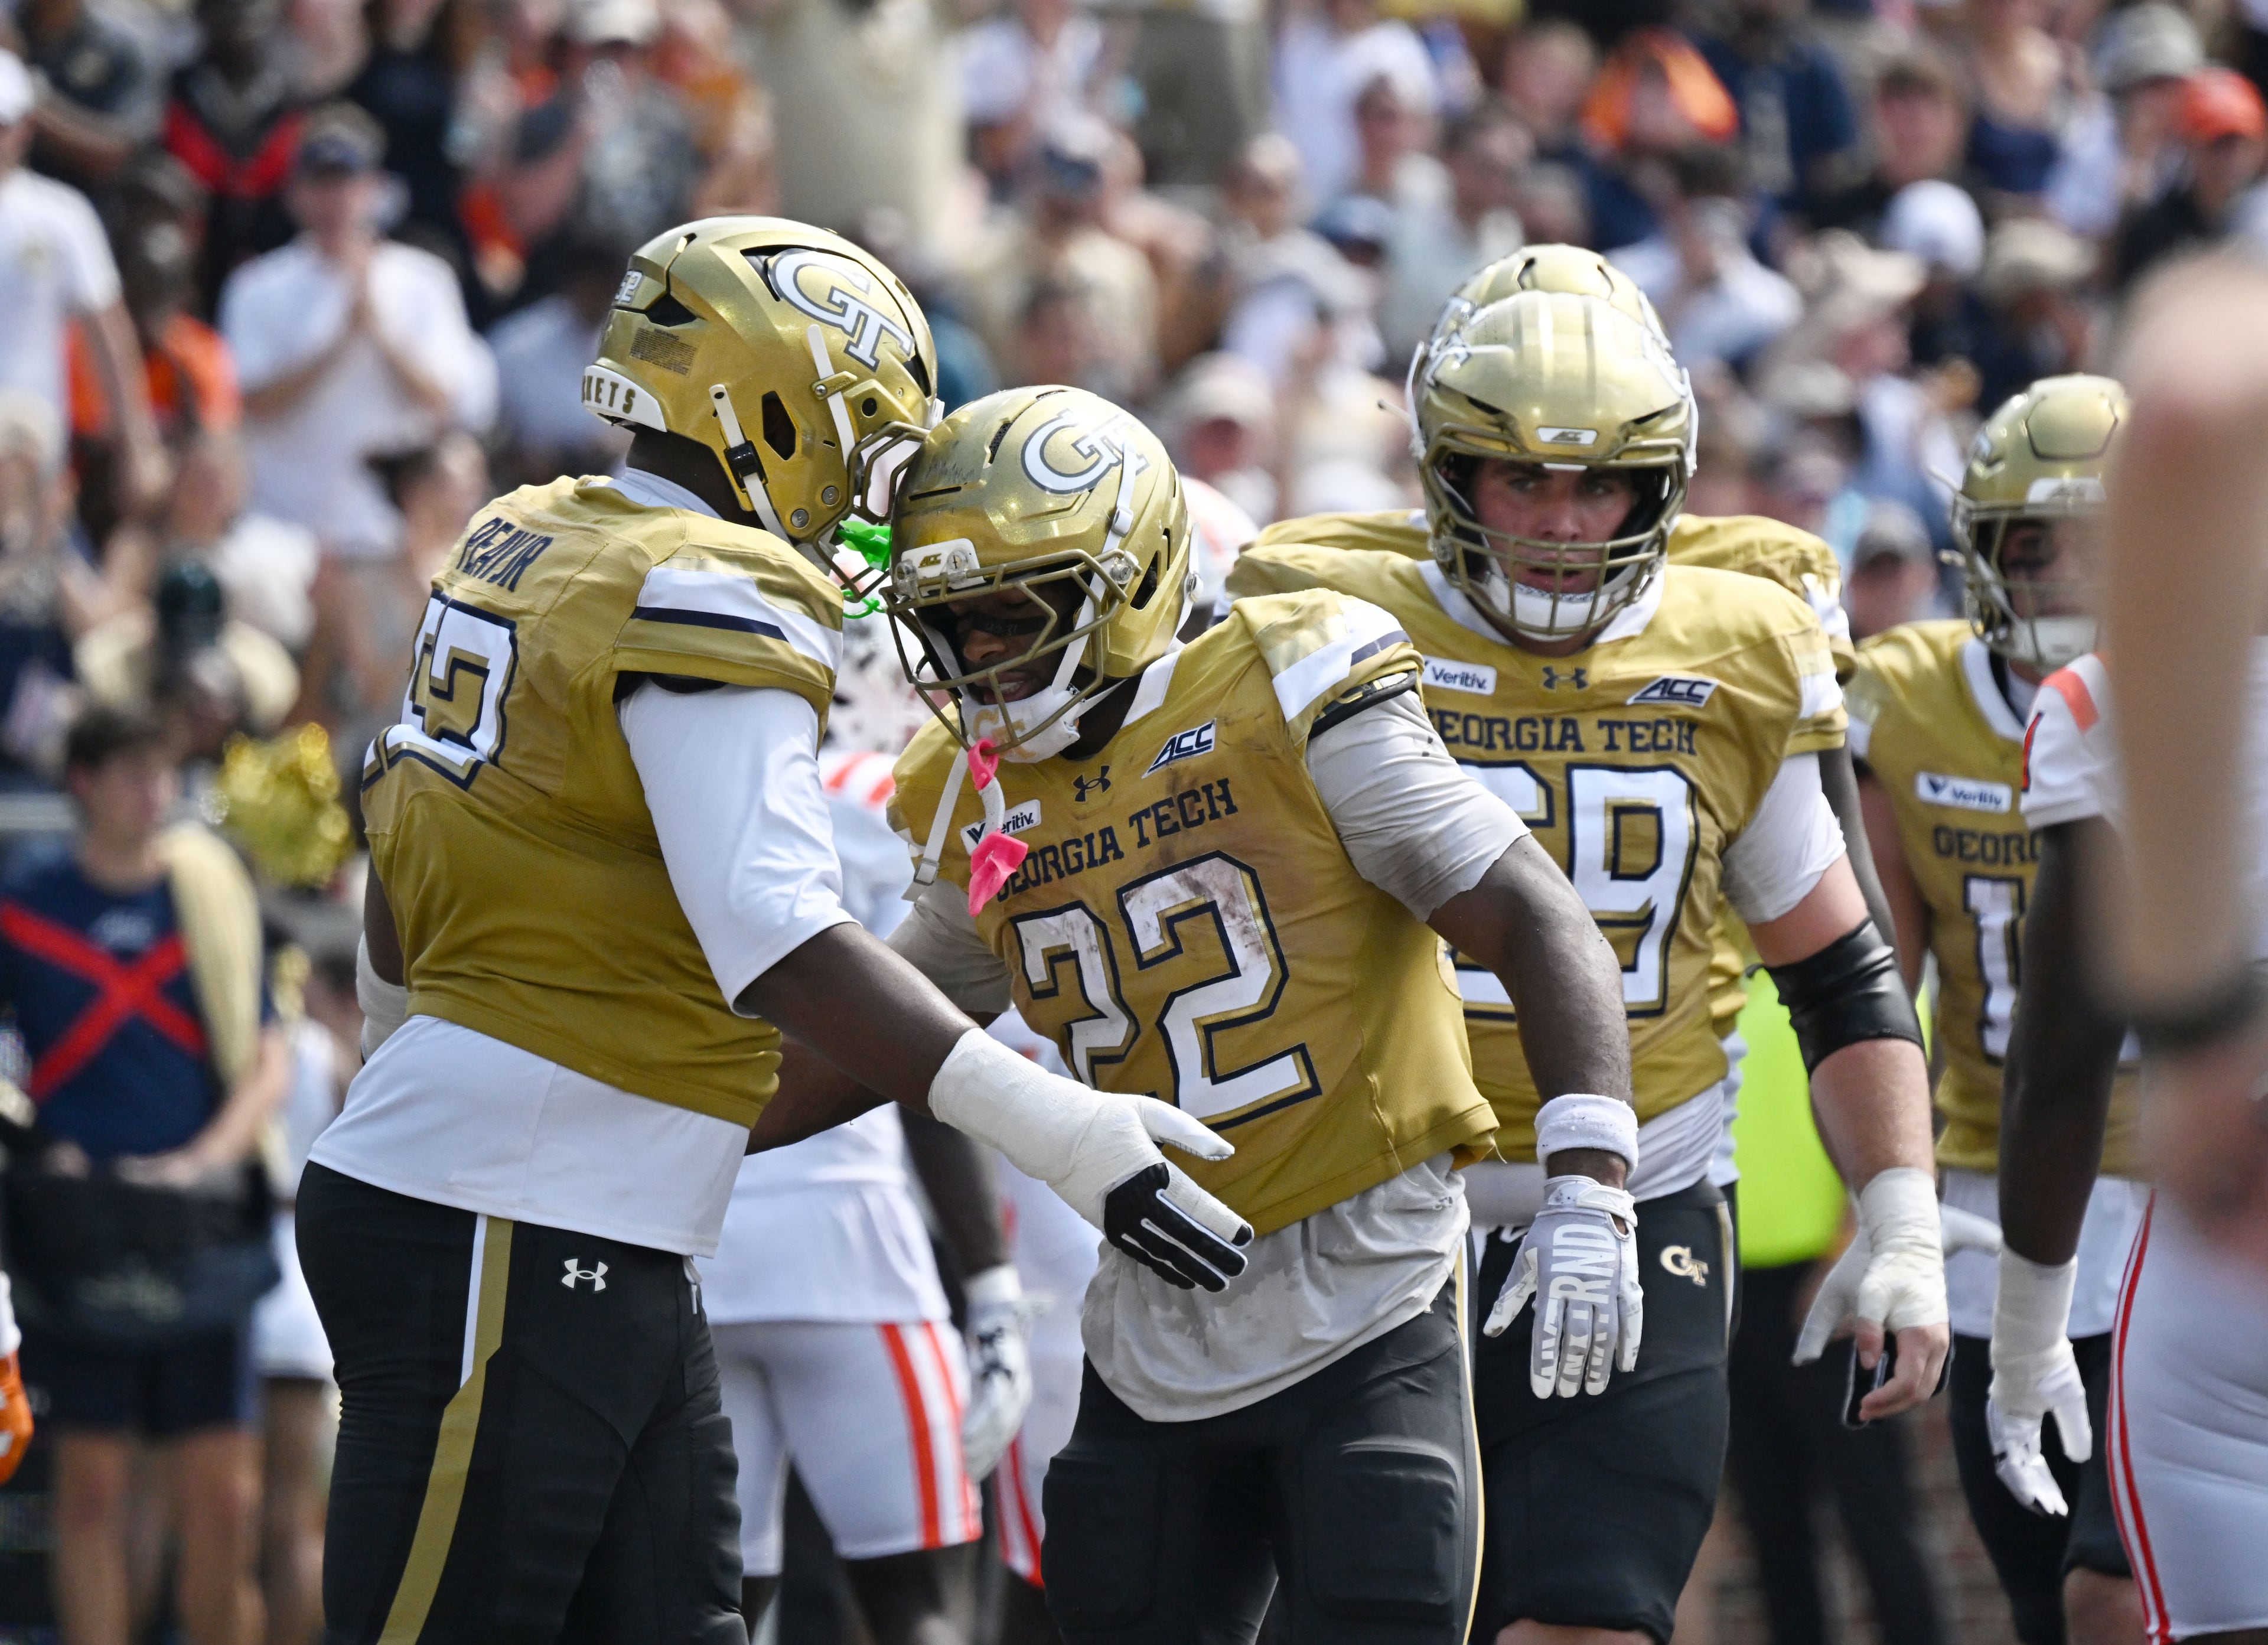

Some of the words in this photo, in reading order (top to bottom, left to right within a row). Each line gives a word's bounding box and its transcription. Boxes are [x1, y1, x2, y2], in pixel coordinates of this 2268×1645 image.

[769, 248, 915, 373] GT
[1635, 678, 1712, 702] ACC
[1152, 722, 1215, 763] ACC
[1426, 708, 1585, 753] EORGIA
[1598, 719, 1697, 756] TECH
[1129, 778, 1239, 849] TECH
[1009, 850, 1322, 1131] 22
